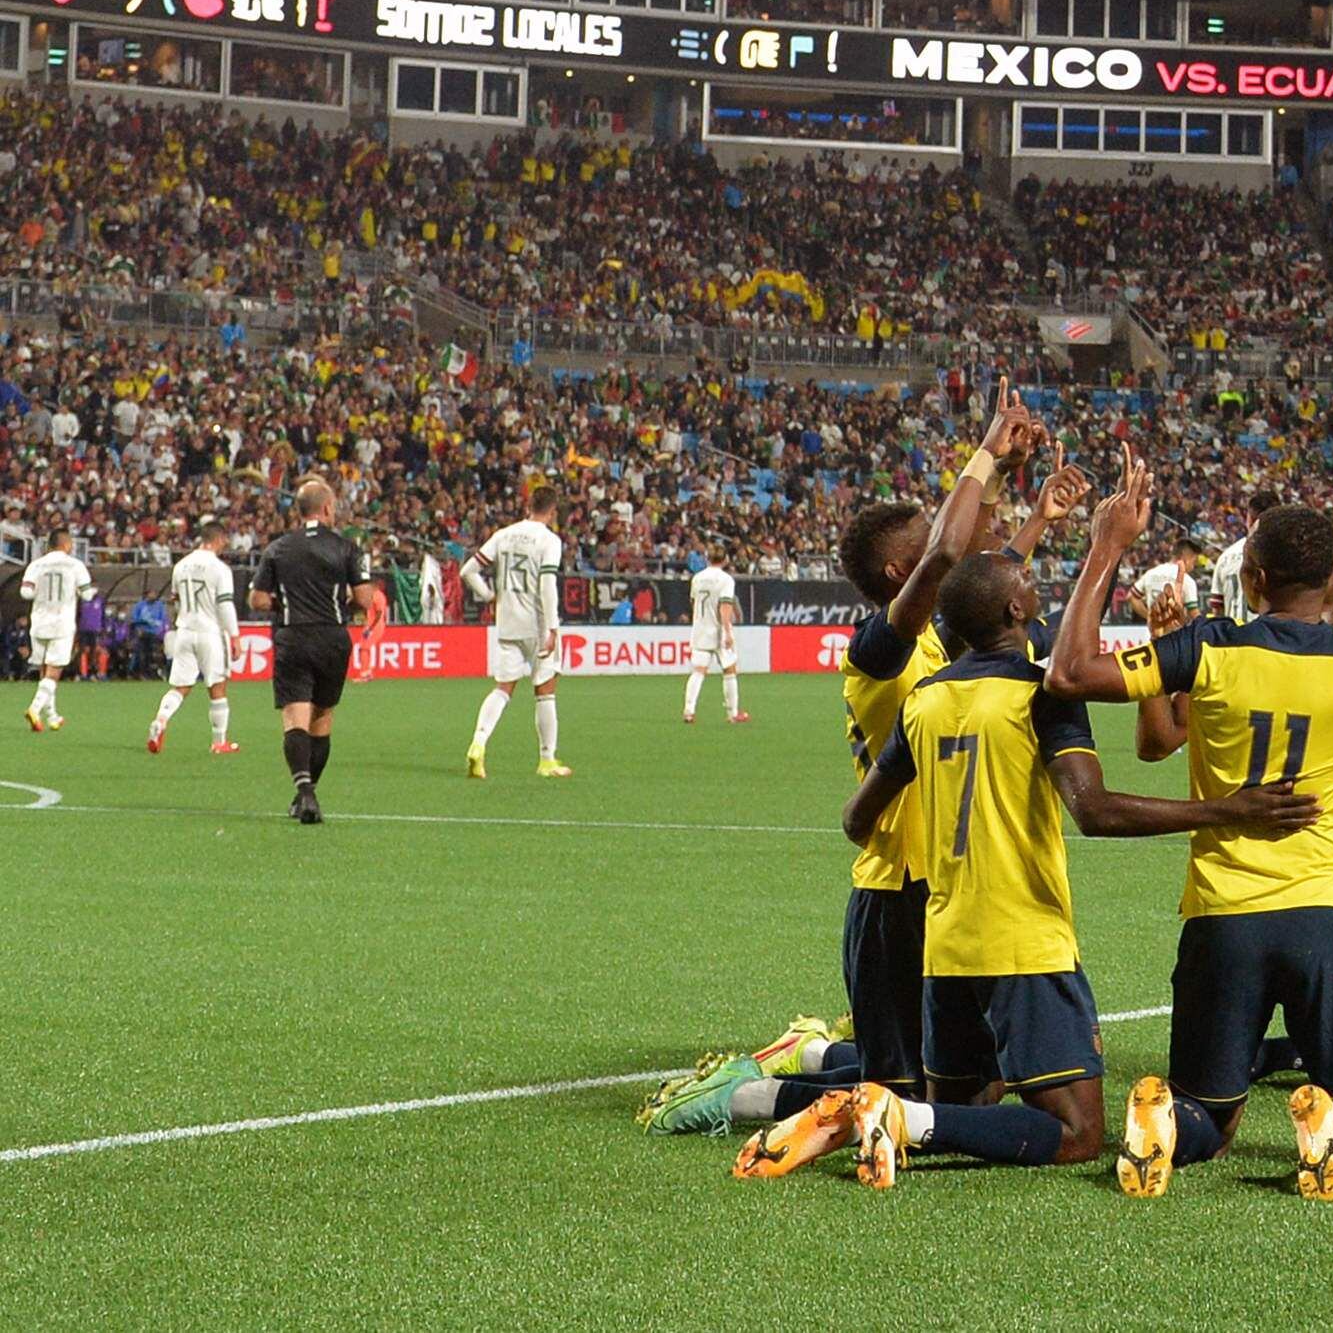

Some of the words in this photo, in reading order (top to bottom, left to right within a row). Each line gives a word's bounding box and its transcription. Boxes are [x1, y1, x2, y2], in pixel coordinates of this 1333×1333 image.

[503, 7, 623, 57] LOCALES
[892, 30, 1143, 90] MEXICO
[1156, 62, 1227, 94] VS.
[44, 572, 64, 601] 11
[501, 551, 529, 594] 13
[1120, 645, 1152, 672] C
[1246, 709, 1312, 788] 11
[938, 734, 979, 859] 7
